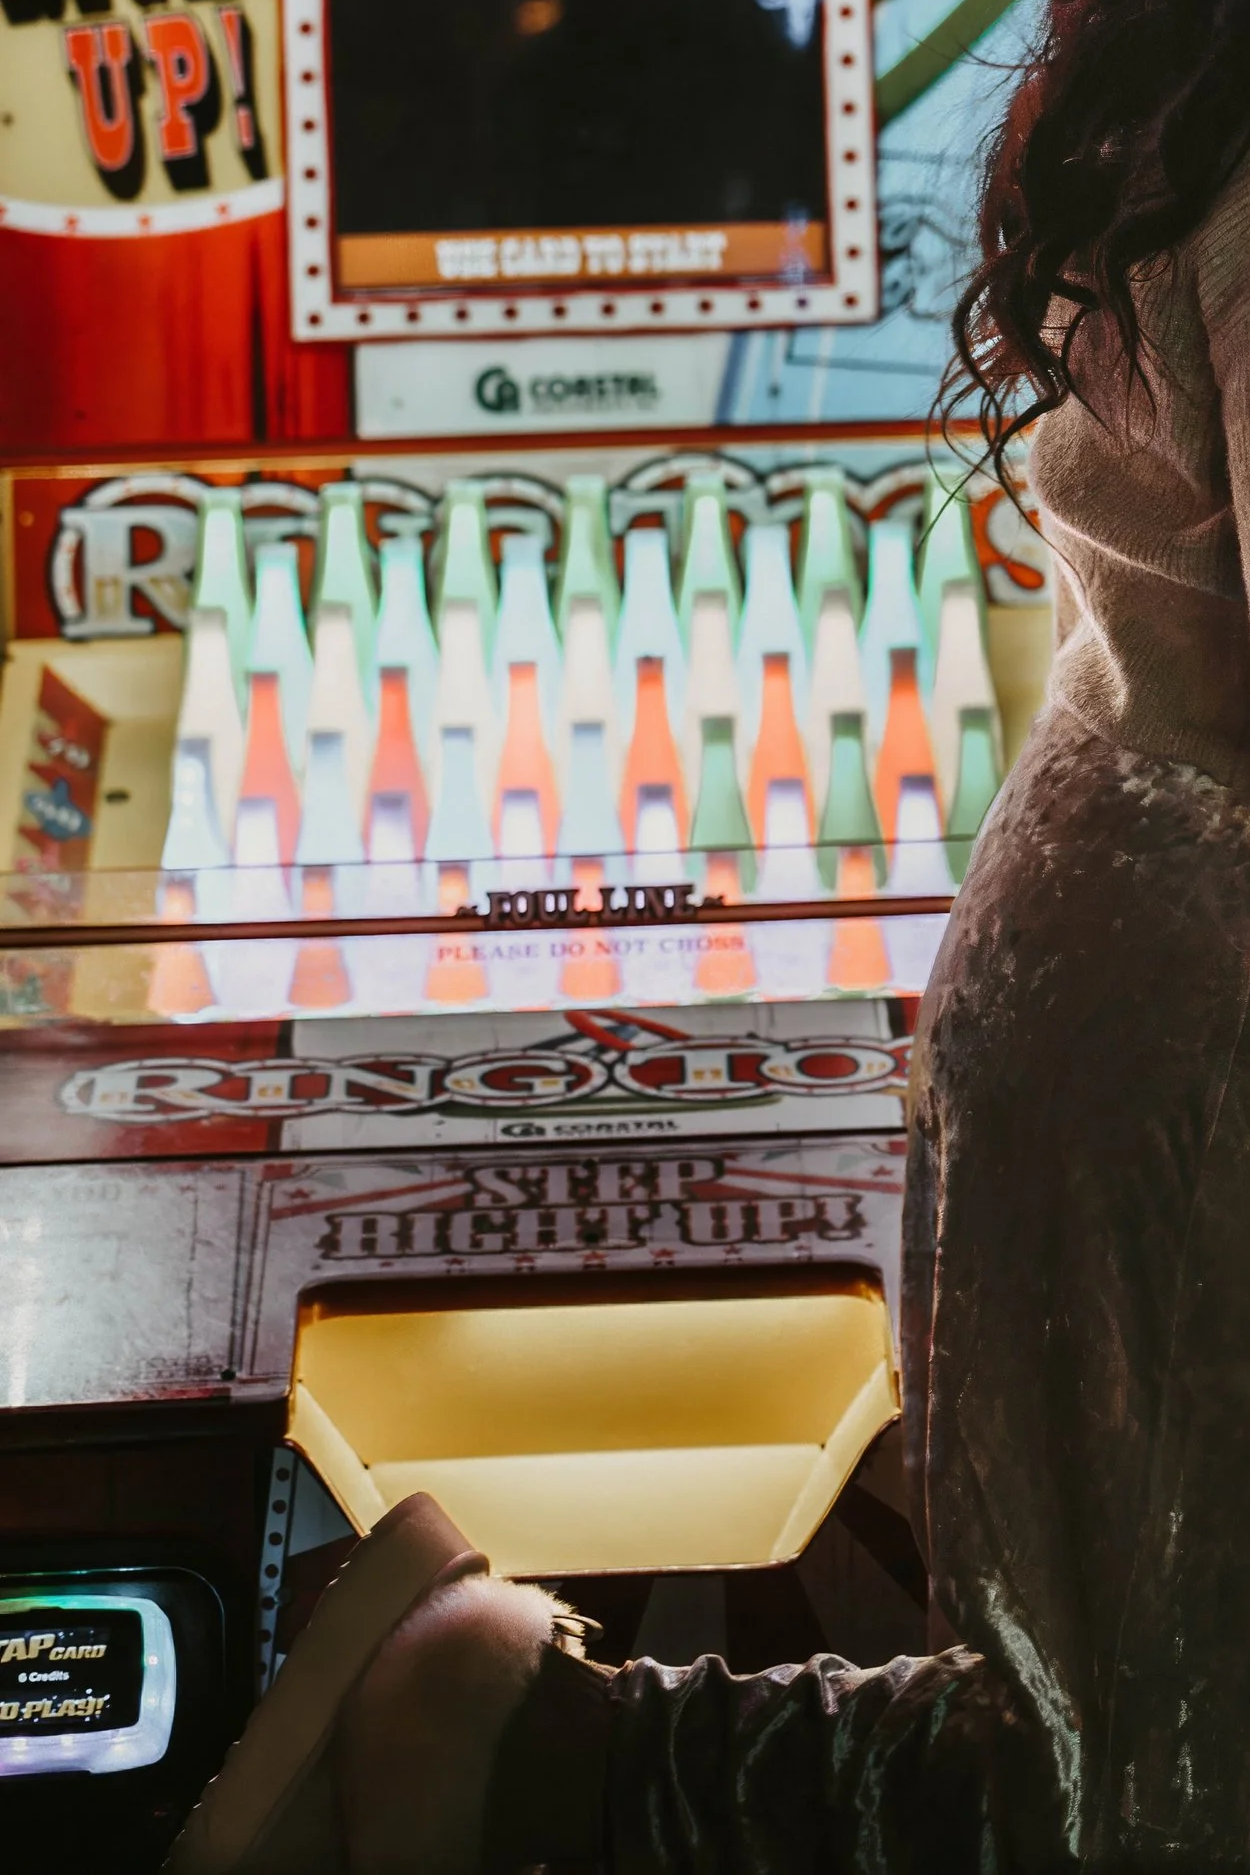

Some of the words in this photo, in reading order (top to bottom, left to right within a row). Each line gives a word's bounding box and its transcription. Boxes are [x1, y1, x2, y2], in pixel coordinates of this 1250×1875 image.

[65, 7, 254, 172] UP!
[487, 889, 588, 925] FOUL
[599, 885, 696, 921] LINE
[436, 942, 539, 962] PLEASE
[550, 941, 585, 959] DO
[594, 939, 649, 957] NOT
[658, 935, 746, 953] CROSS
[85, 1061, 579, 1117] RING
[627, 1043, 913, 1092] TO
[468, 1158, 722, 1210] STEP
[328, 1205, 652, 1258] RIGHT
[686, 1194, 862, 1246] UP!
[49, 1644, 107, 1661] CARD
[28, 1671, 70, 1683] Credits
[23, 1697, 105, 1719] PLAY!
